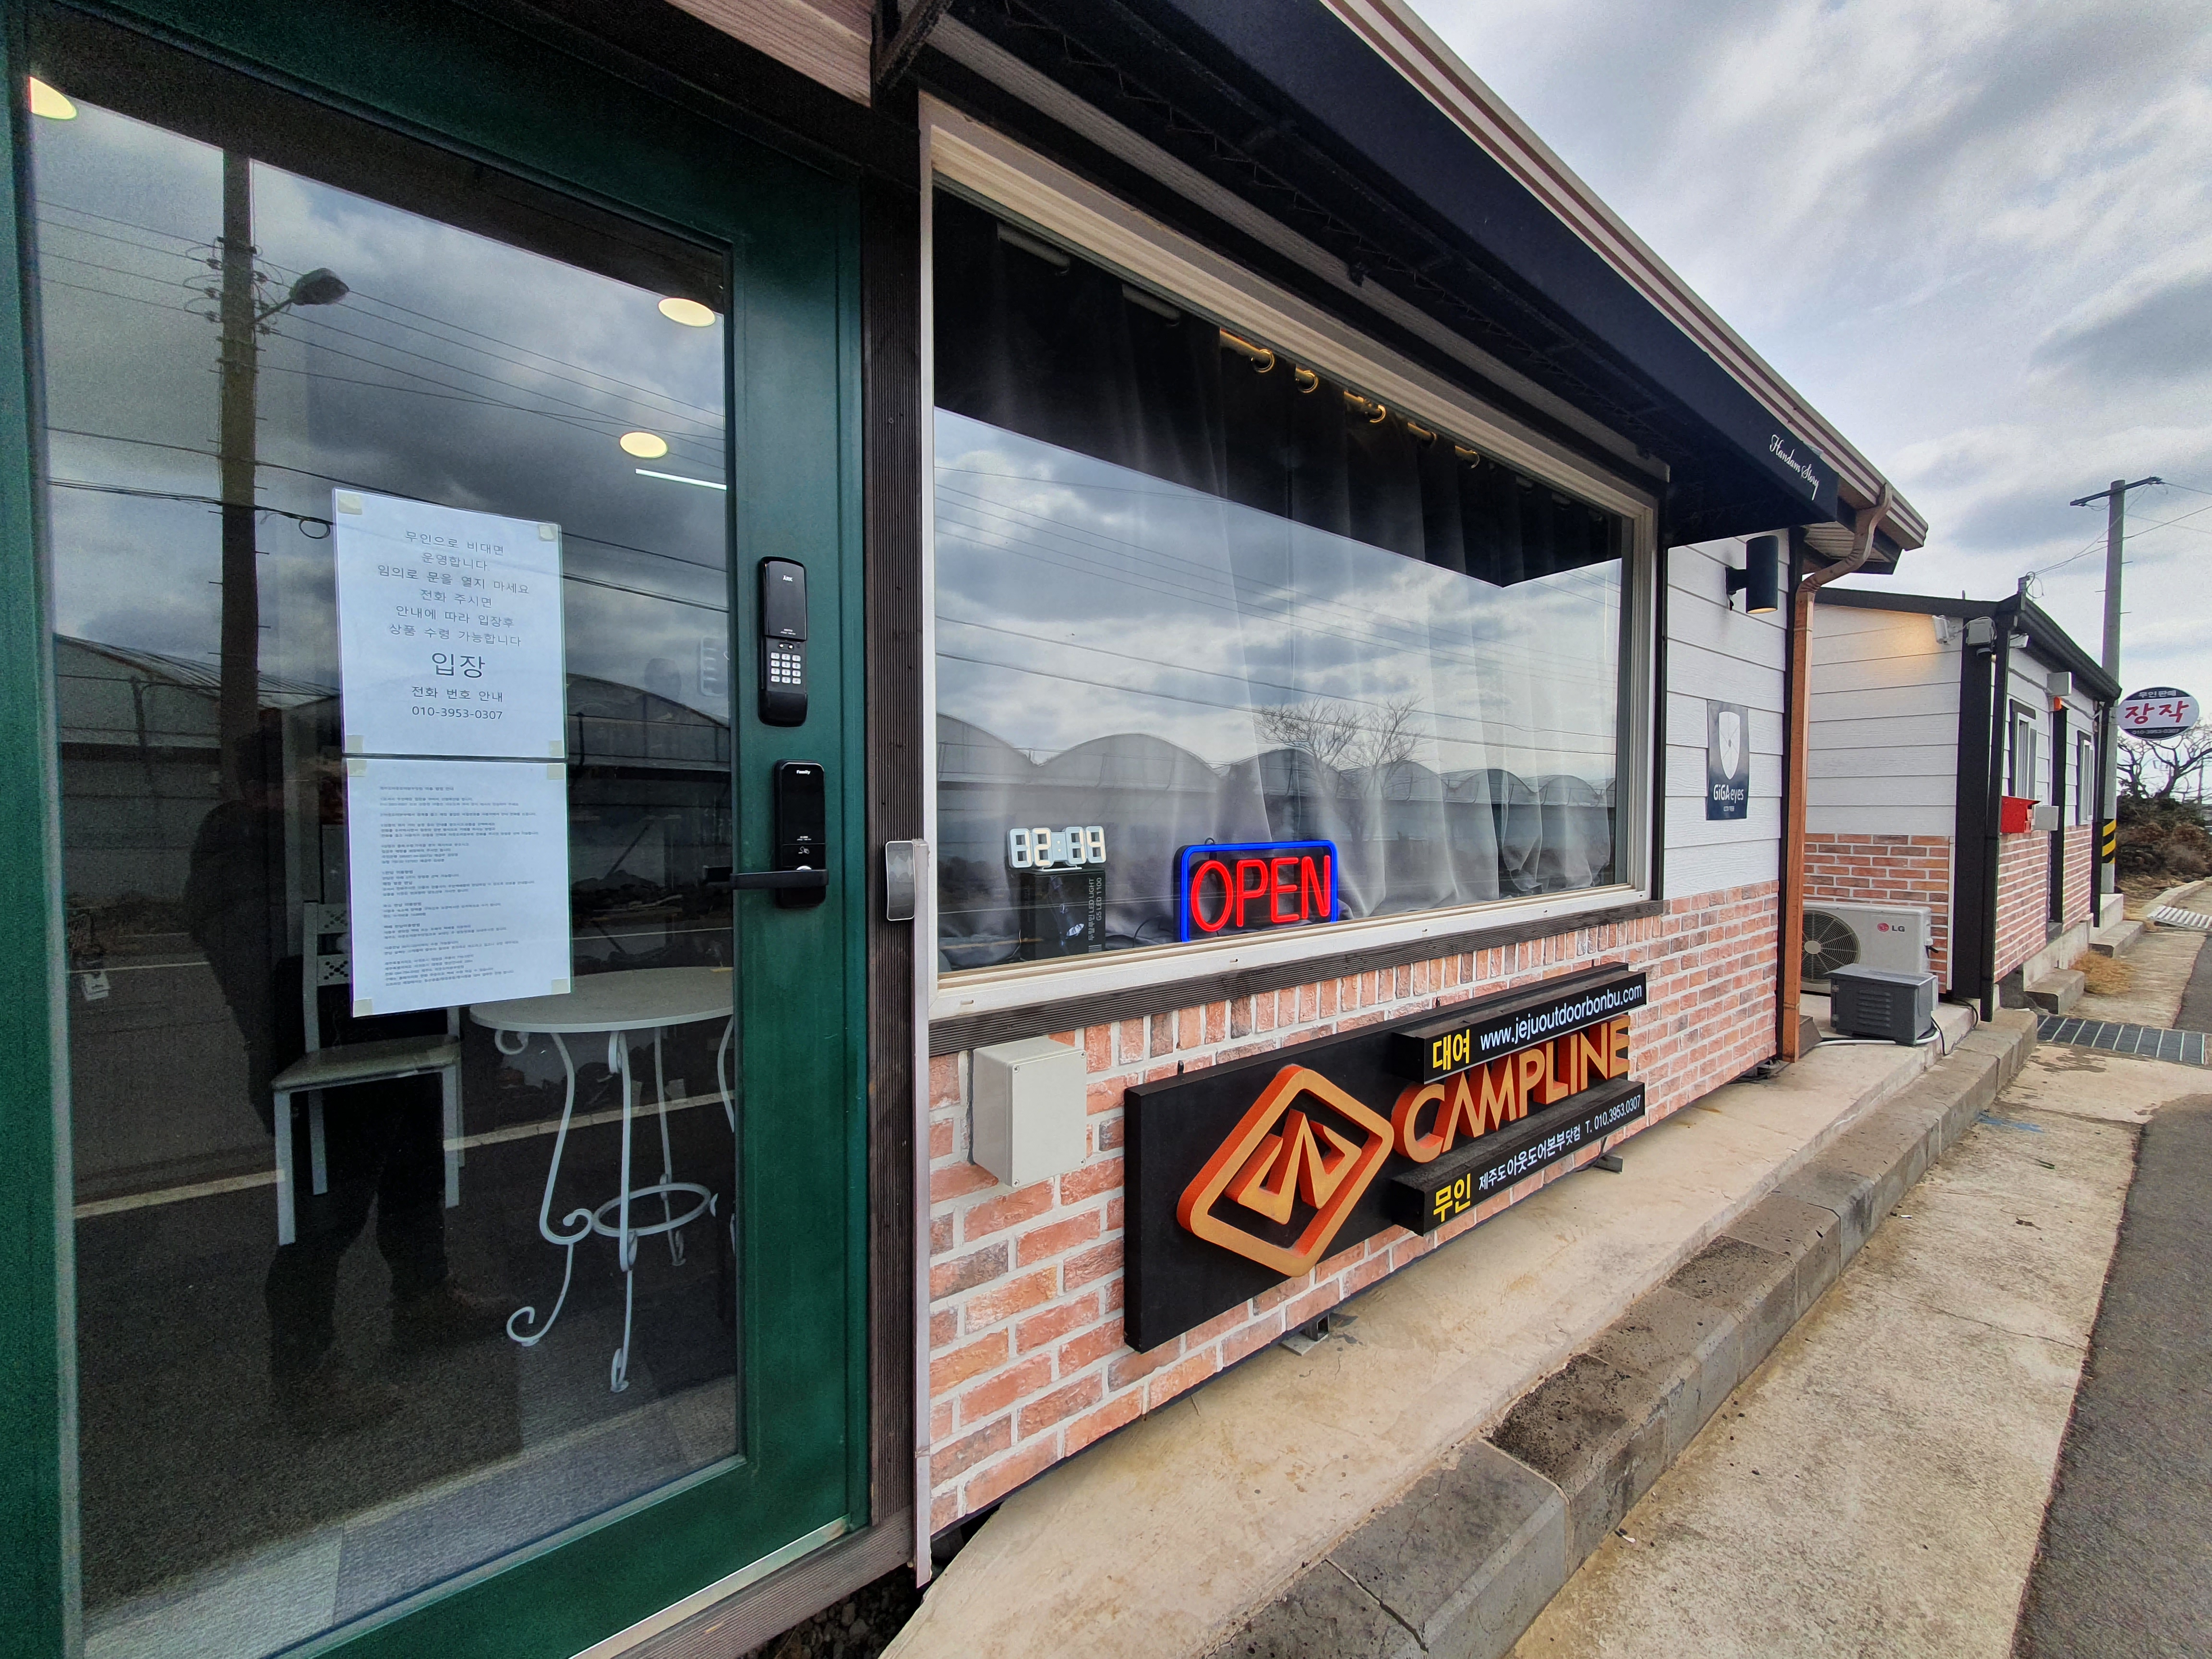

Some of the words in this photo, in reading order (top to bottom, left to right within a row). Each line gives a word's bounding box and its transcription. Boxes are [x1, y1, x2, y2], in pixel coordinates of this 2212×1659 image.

[1769, 434, 1801, 473] Handam
[1801, 464, 1819, 501] Story
[405, 531, 459, 549] 무인으로
[467, 541, 504, 556] 비대면
[378, 565, 419, 580] 임의로
[427, 572, 453, 586] 문을
[461, 576, 485, 589] 열지
[493, 580, 529, 594] 마세요
[420, 589, 446, 602] 전화
[454, 593, 492, 608] 주시면
[396, 605, 436, 620] 안내에
[445, 611, 470, 624] 따라
[478, 614, 515, 628] 입장후
[389, 624, 416, 637] 상품
[424, 627, 450, 640] 수령
[458, 631, 521, 647] 가능합니다
[432, 652, 486, 678] 입장
[411, 686, 438, 698] 전화
[446, 689, 471, 700] 번호
[479, 691, 503, 703] 안내
[412, 706, 503, 720] 010-3953-0307
[2125, 700, 2189, 724] 장작
[1190, 855, 1331, 932] OPEN
[1432, 1029, 1470, 1071] 대여
[1480, 984, 1642, 1051] www.jejuoutdoorbonbu.com
[1392, 1014, 1630, 1163] CAMPLINE
[1433, 1173, 1470, 1222] 무인
[1585, 1120, 1592, 1133] T.
[1594, 1094, 1641, 1130] 010.3953.0307
